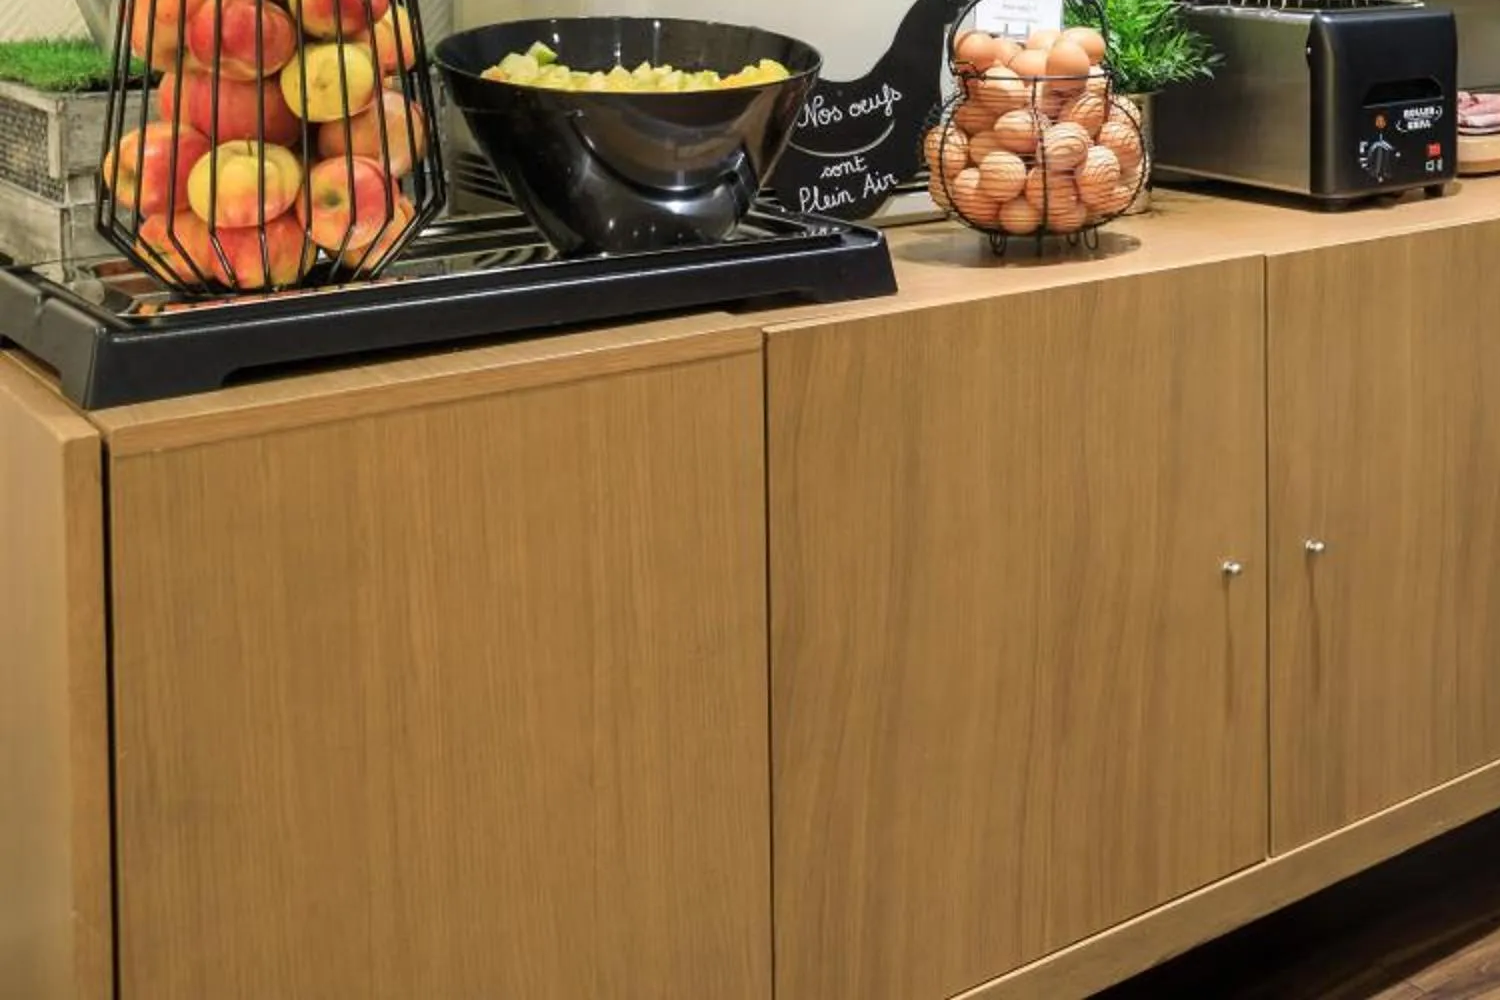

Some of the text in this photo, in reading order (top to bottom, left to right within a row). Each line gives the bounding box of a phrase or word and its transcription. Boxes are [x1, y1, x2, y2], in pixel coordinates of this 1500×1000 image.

[797, 95, 844, 128] Nos
[820, 155, 869, 180] sont
[799, 171, 899, 214] Plein Air
